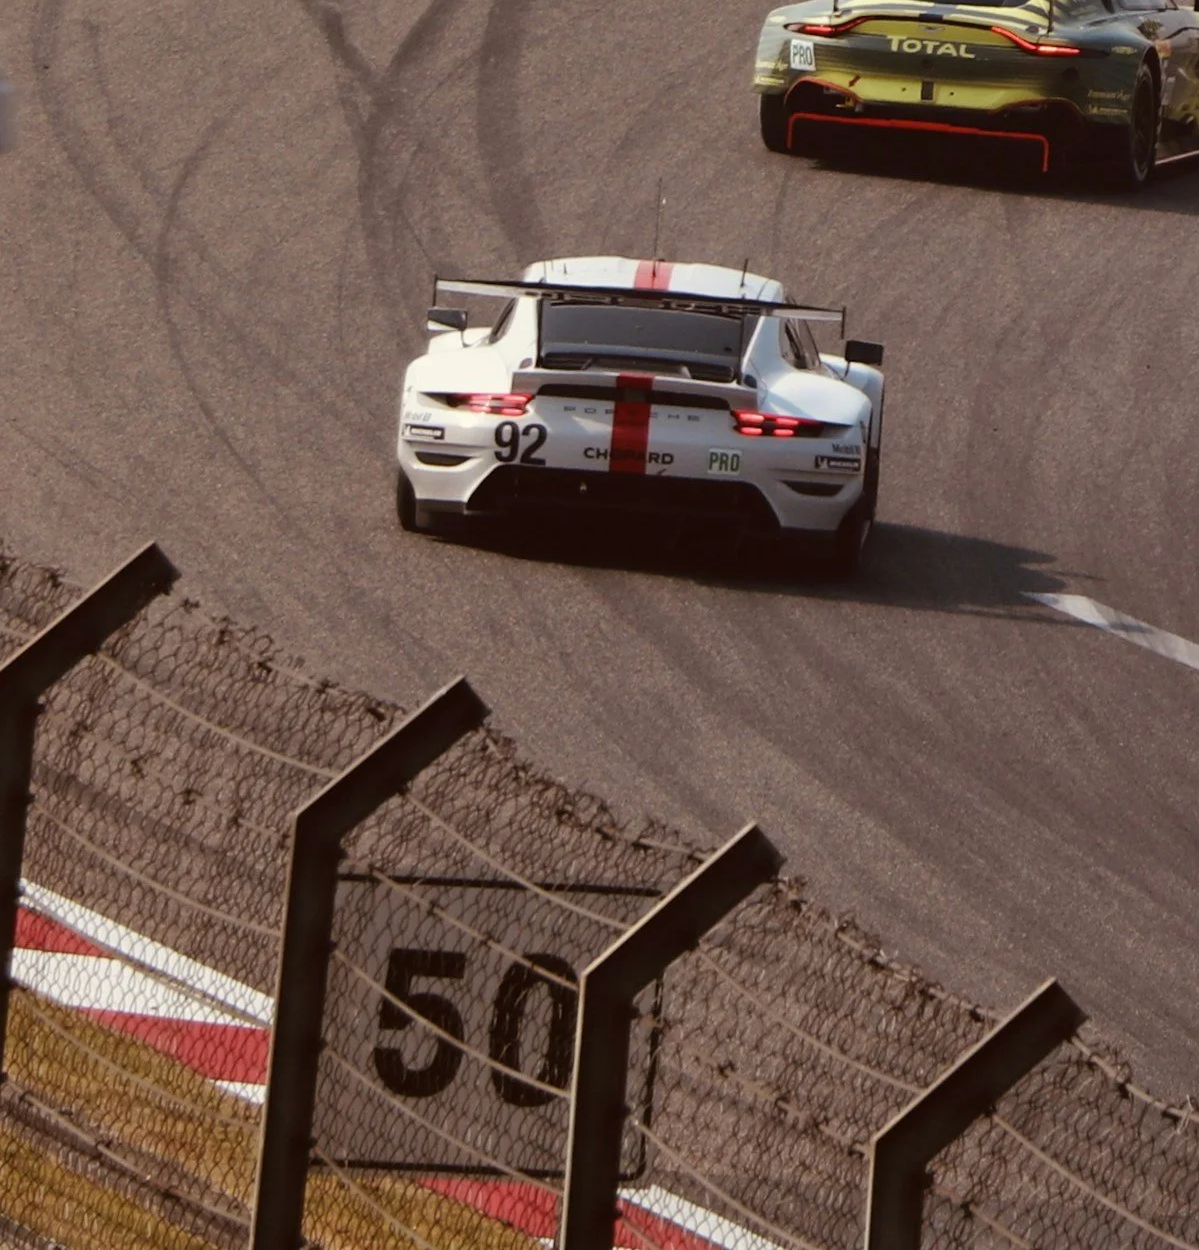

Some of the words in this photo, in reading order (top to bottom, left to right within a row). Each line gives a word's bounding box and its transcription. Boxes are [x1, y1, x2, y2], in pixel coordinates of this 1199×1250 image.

[792, 44, 813, 66] PRO
[886, 35, 976, 59] TOTAL
[494, 421, 548, 466] 92
[583, 447, 675, 465] CHPARD
[708, 452, 741, 472] PRO
[373, 948, 579, 1107] 50
